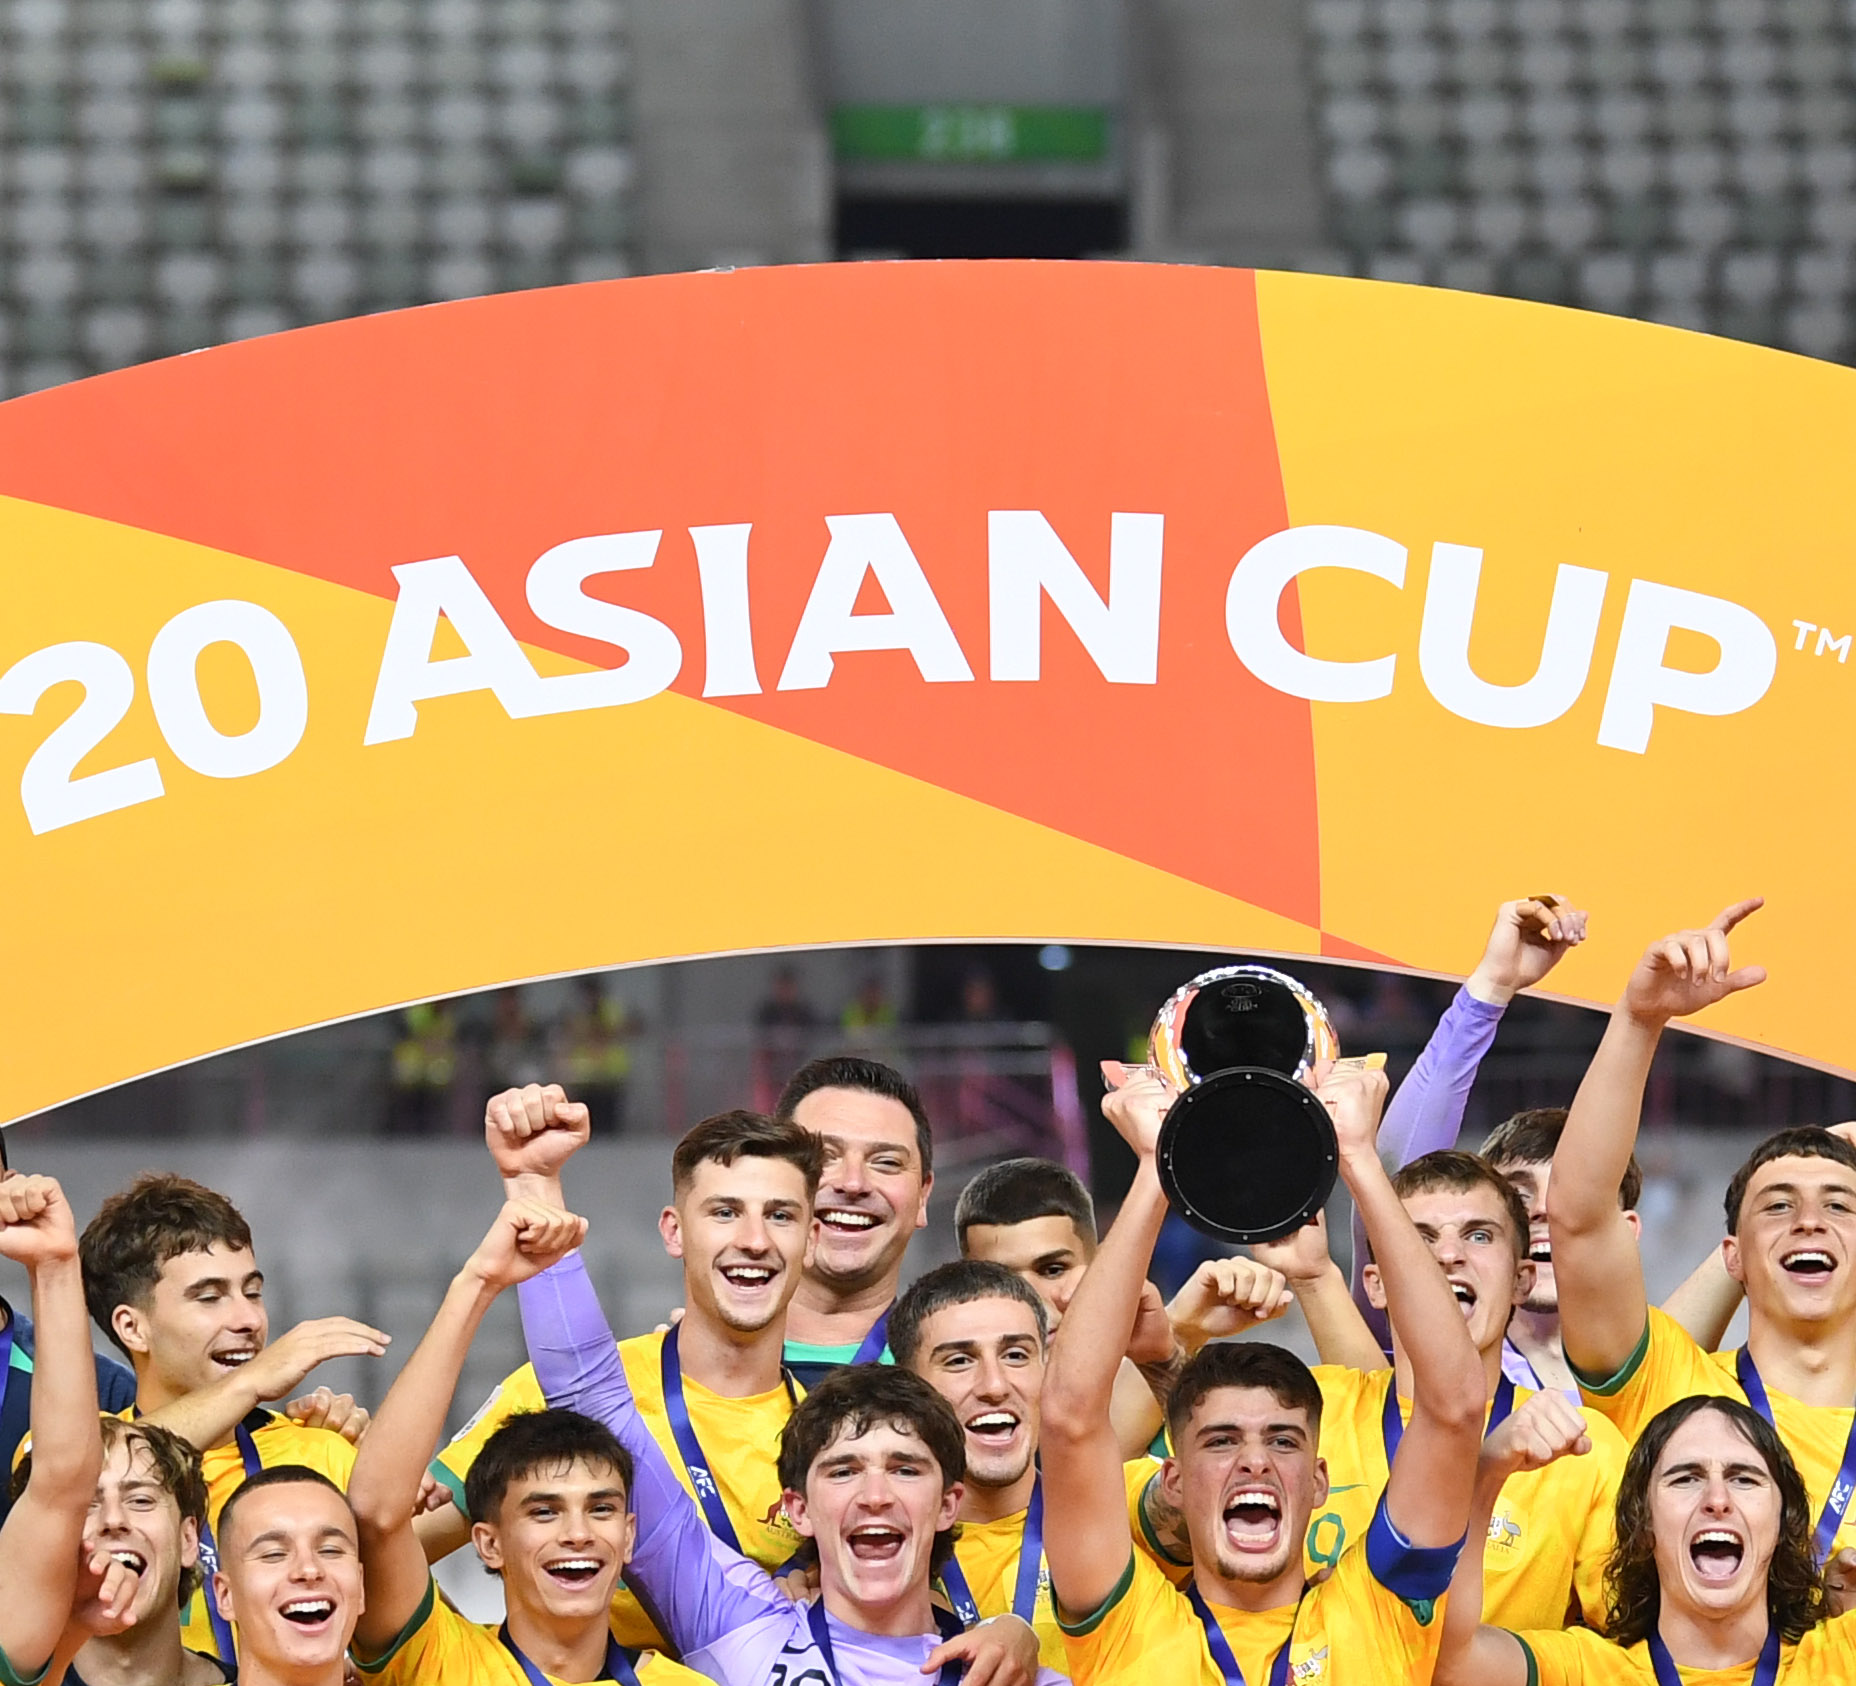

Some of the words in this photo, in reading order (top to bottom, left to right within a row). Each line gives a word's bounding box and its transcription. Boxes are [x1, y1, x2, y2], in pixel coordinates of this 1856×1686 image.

[362, 509, 1166, 747] ASIAN
[1225, 523, 1778, 756] CUP
[690, 1465, 717, 1498] AFC
[1829, 1479, 1850, 1516] AFC
[955, 1601, 975, 1620] FC
